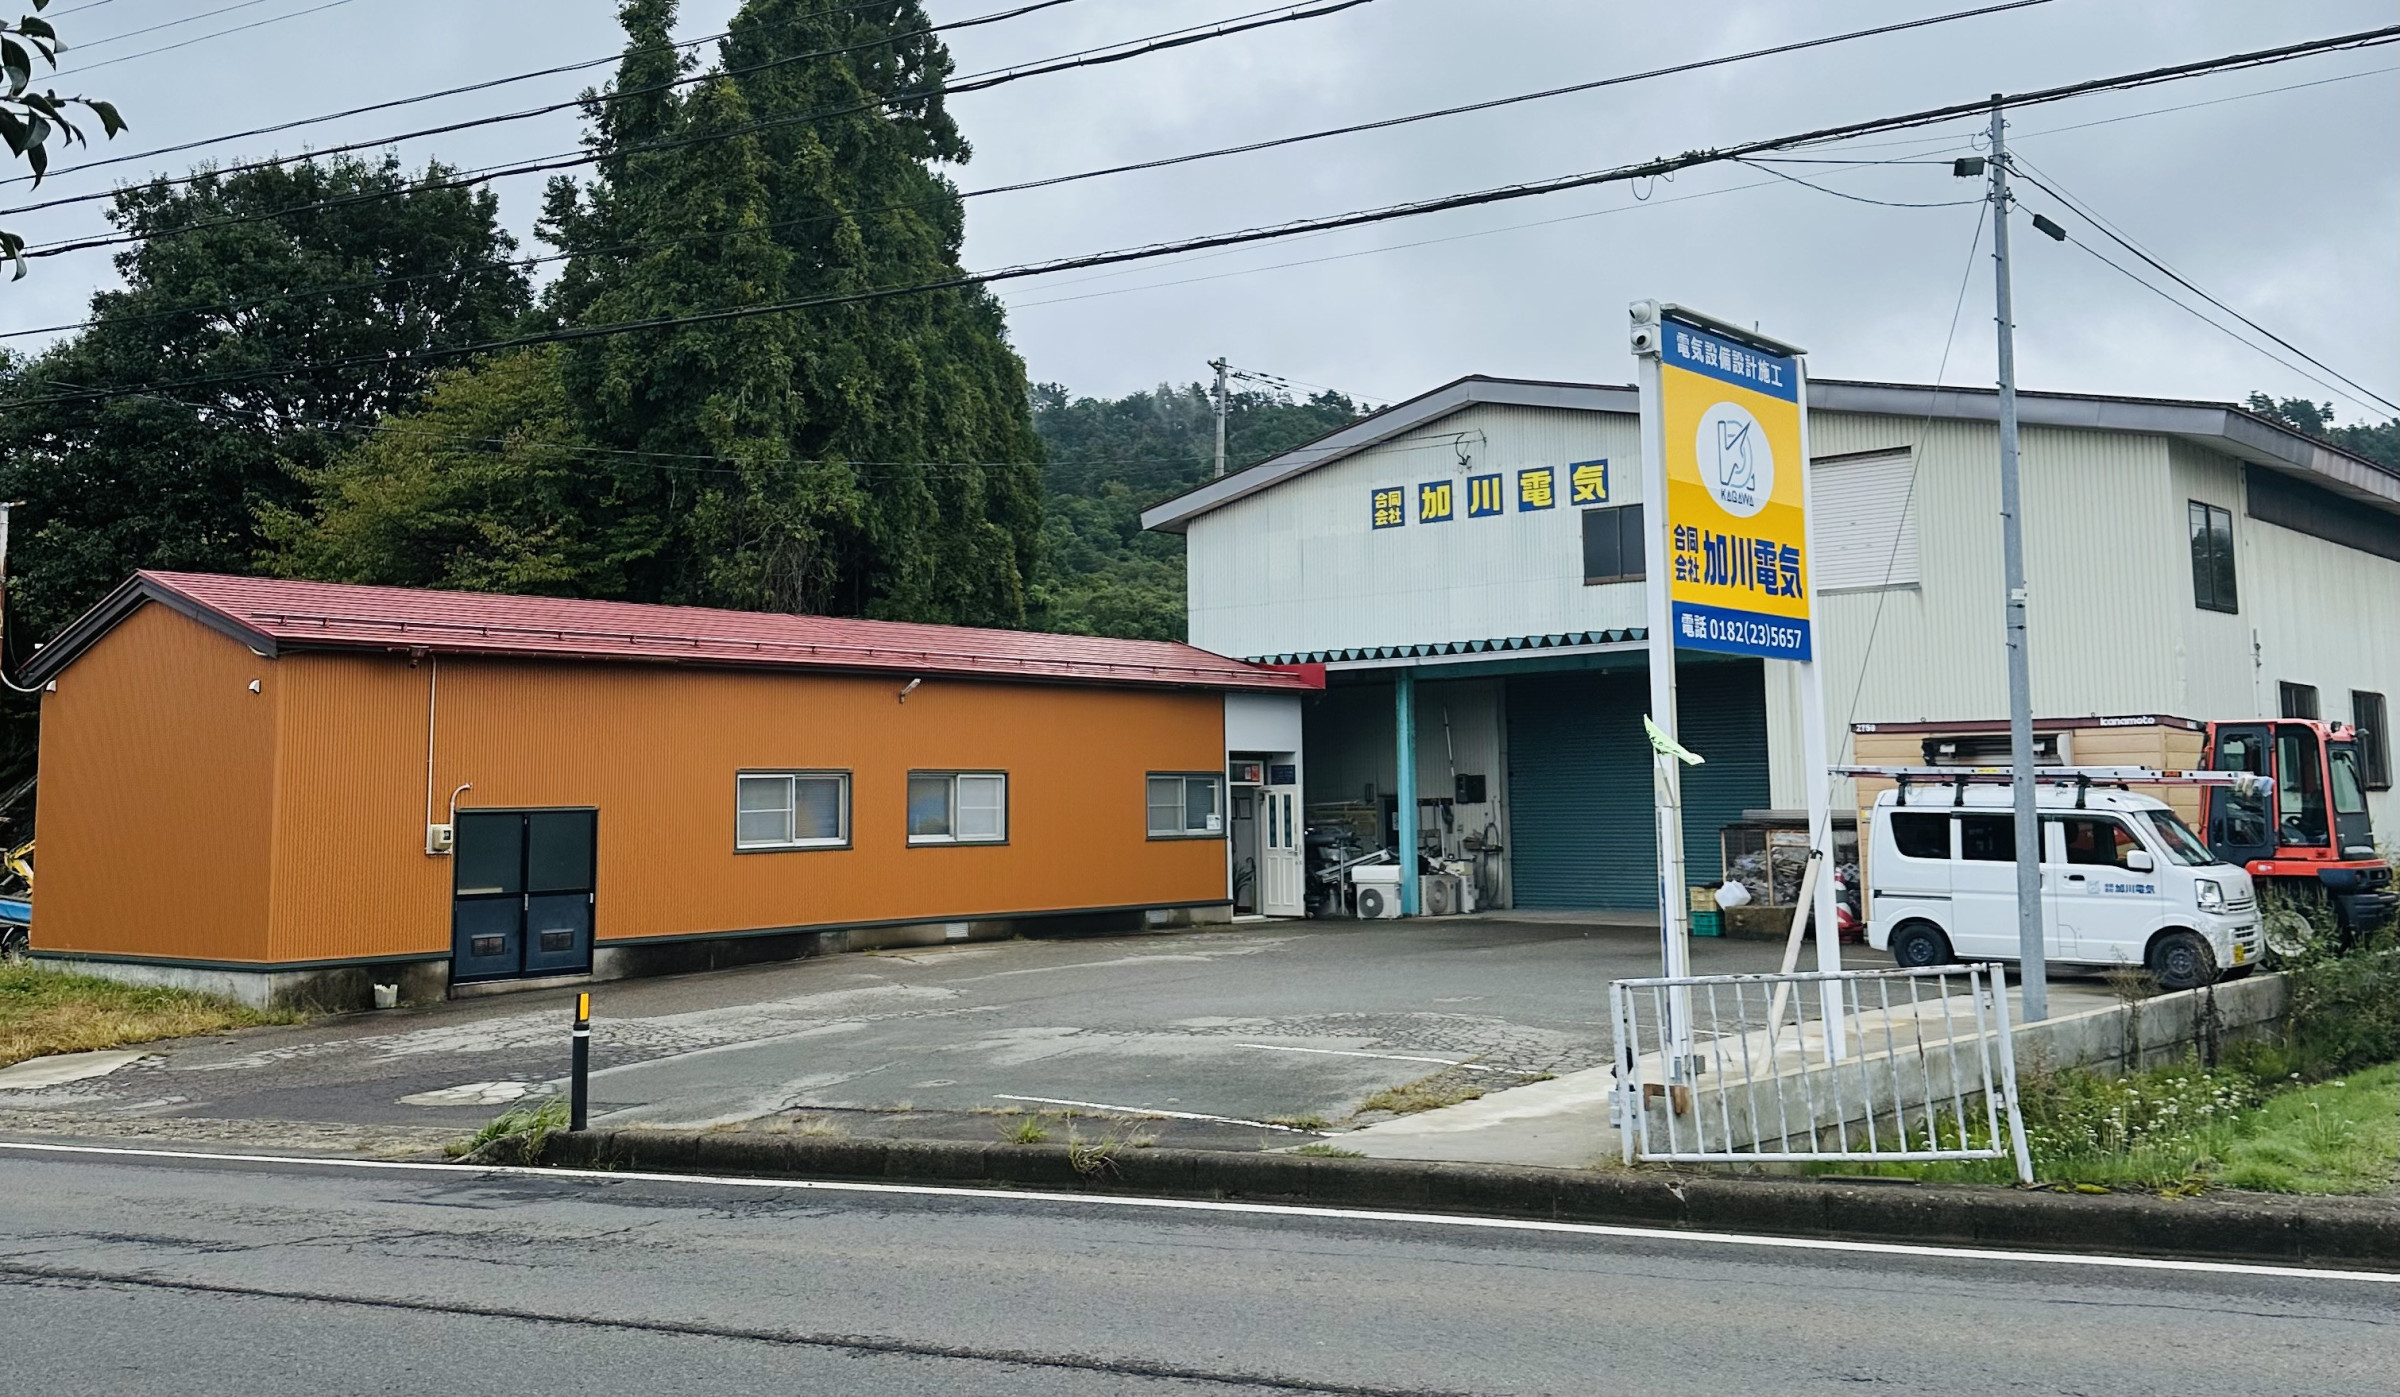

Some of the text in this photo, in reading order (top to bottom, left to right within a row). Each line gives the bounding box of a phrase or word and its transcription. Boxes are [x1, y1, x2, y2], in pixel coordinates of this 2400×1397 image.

[1676, 331, 1783, 388] 電気設備設計施工
[1374, 491, 1402, 508] 合同
[1421, 464, 1607, 520] 加川電気
[1720, 488, 1755, 508] KAGAWA
[1374, 506, 1402, 526] 会社
[1673, 523, 1699, 554] 合同
[1674, 553, 1701, 584] 会社
[1703, 529, 1803, 600] 加川電気
[1681, 613, 1802, 649] 電話 0182(23)5657
